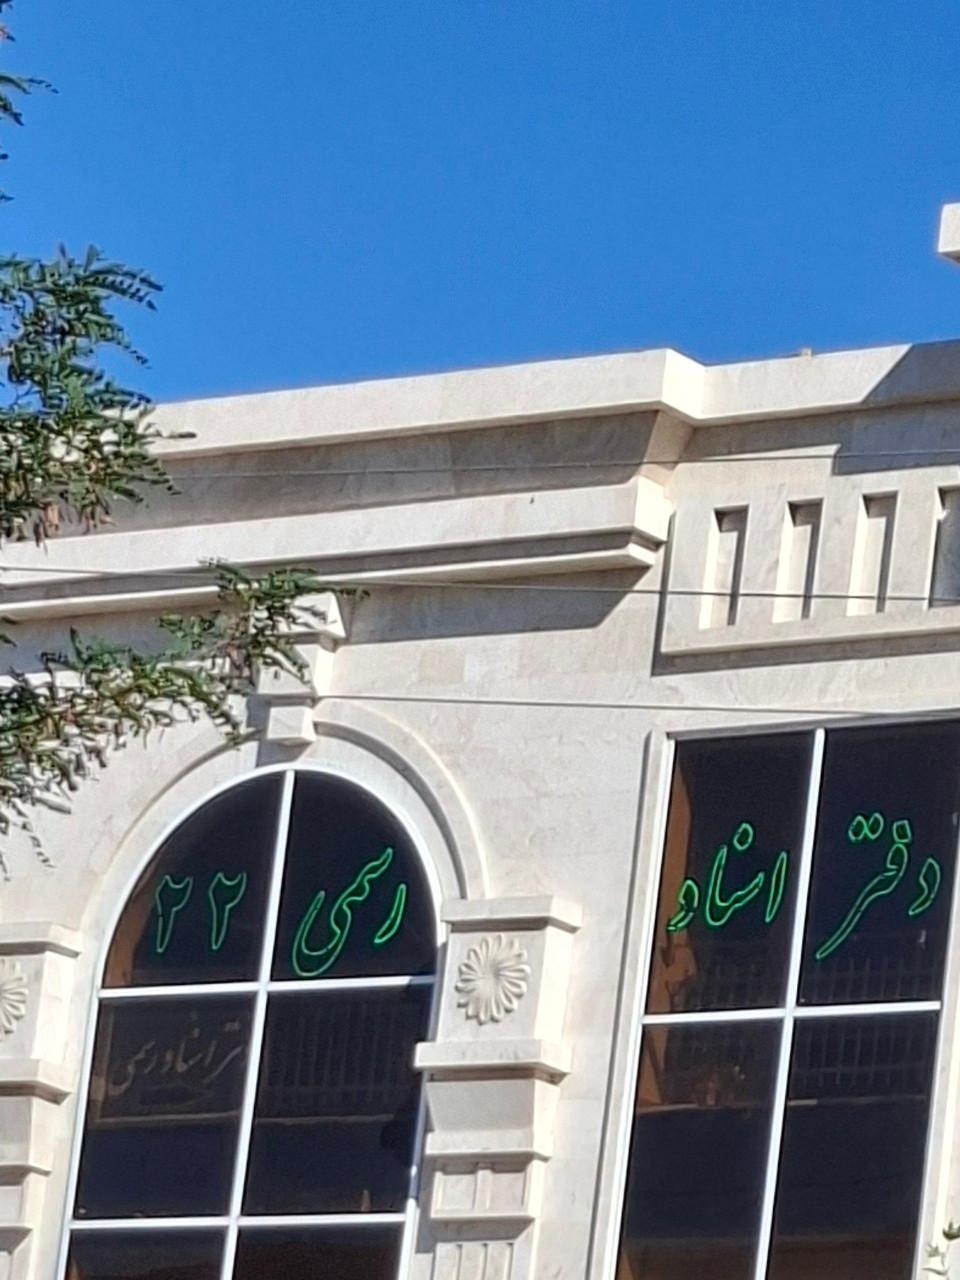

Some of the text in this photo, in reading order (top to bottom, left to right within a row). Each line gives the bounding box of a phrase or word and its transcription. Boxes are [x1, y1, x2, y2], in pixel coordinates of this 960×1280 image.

[154, 847, 407, 978] رسمی ۲۲
[666, 812, 941, 960] دفتر اسناد
